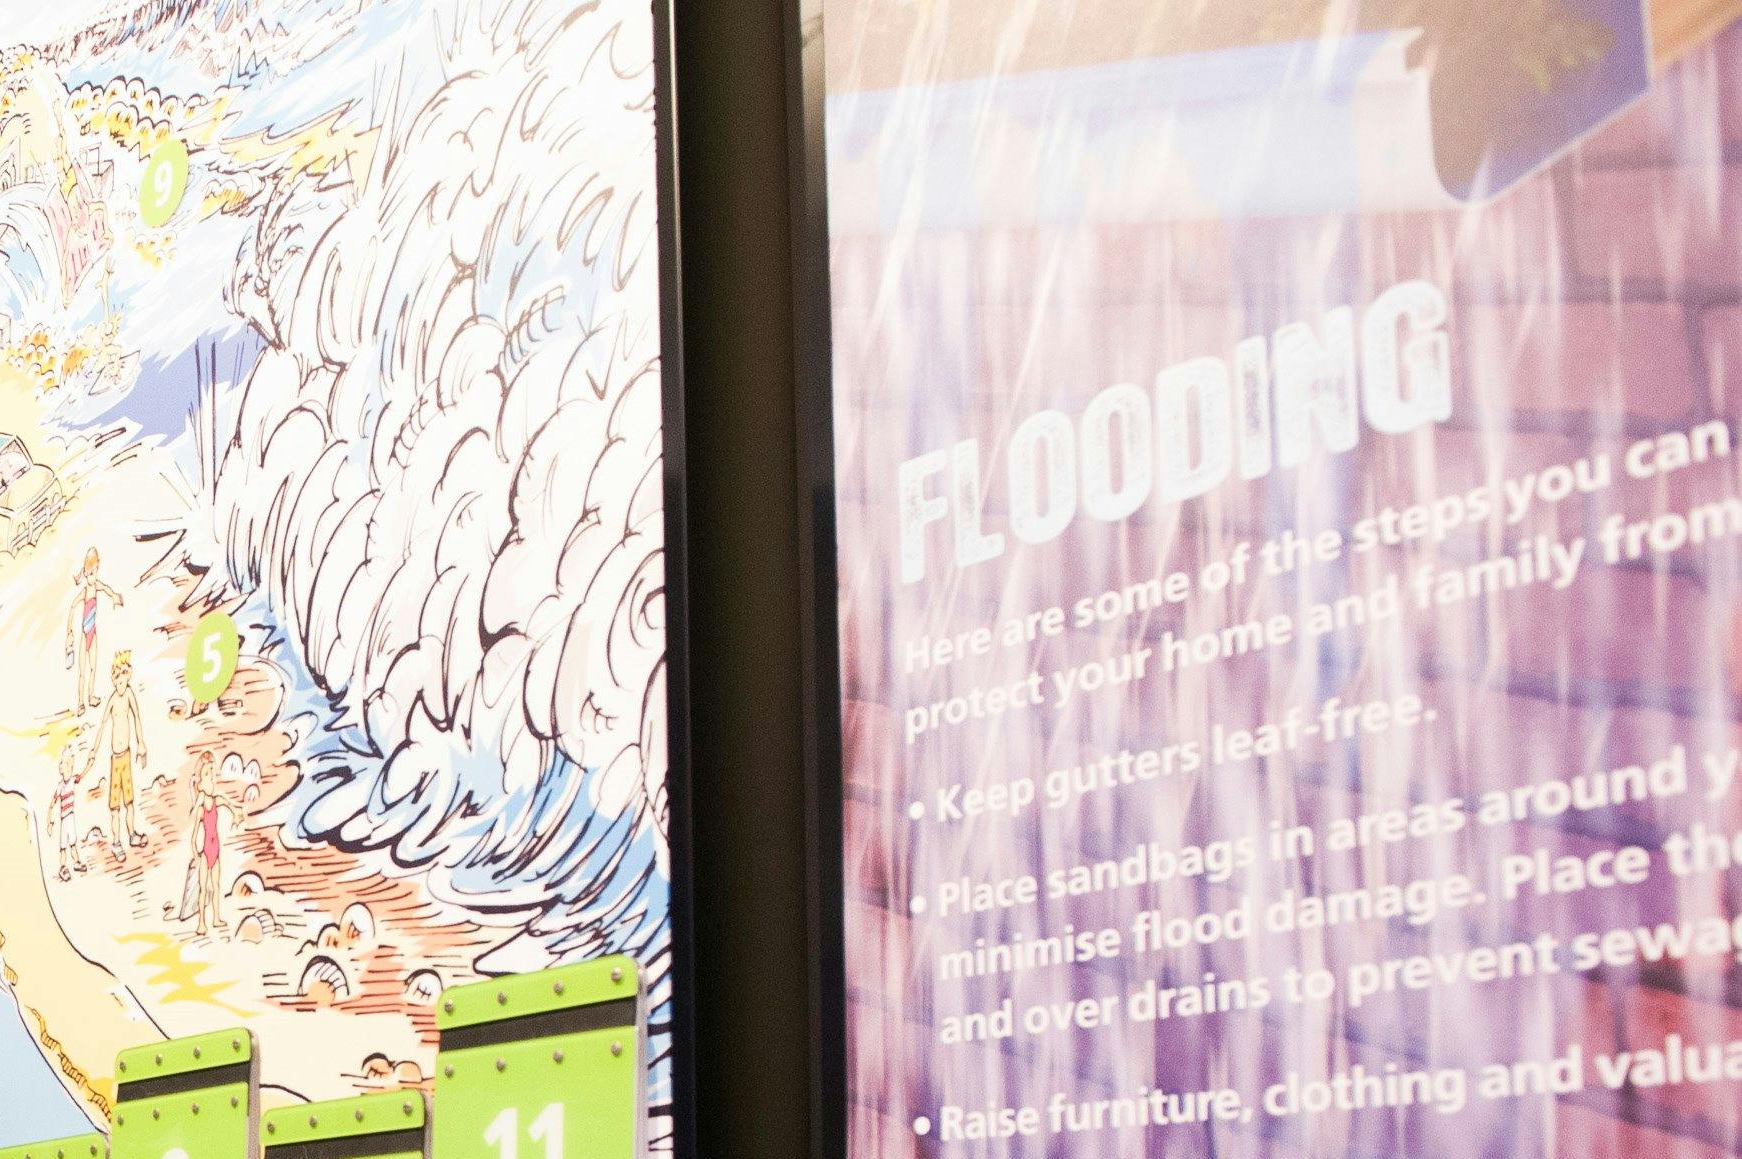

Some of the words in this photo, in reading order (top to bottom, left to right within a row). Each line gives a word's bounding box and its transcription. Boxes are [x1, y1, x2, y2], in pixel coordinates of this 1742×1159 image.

[154, 160, 173, 207] 9
[898, 279, 1453, 583] FLOODING
[905, 626, 991, 673] Here
[1002, 607, 1065, 648] are
[1074, 571, 1190, 628] some
[1200, 541, 1251, 591] of
[1260, 529, 1343, 577] the
[1352, 487, 1492, 553] steps
[1502, 454, 1611, 524] you
[1625, 419, 1730, 478] can
[202, 632, 221, 683] 5
[906, 671, 1044, 744] protect
[1054, 647, 1151, 709] your
[1163, 613, 1292, 671] home
[1305, 574, 1398, 635] and
[1414, 536, 1584, 609] family
[1601, 497, 1742, 564] from
[936, 776, 1034, 821] Keep
[1045, 737, 1201, 808] gutters
[1213, 692, 1437, 765] leaf-free.
[939, 875, 1037, 916] Place
[1048, 836, 1256, 900] sandbags
[1268, 820, 1313, 860] in
[1327, 796, 1466, 852] areas
[1479, 745, 1687, 826] around
[941, 925, 1120, 981] minimise
[1132, 898, 1251, 953] flood
[1267, 874, 1484, 933] damage.
[1501, 845, 1650, 899] Place
[941, 999, 1012, 1044] and
[1024, 994, 1119, 1035] over
[1128, 973, 1270, 1023] drains
[1284, 967, 1335, 1003] to
[1349, 932, 1560, 1006] prevent
[940, 1104, 1039, 1142] Raise
[1047, 1087, 1252, 1133] furniture,
[1264, 1063, 1465, 1118] clothing
[1479, 1045, 1583, 1097] and
